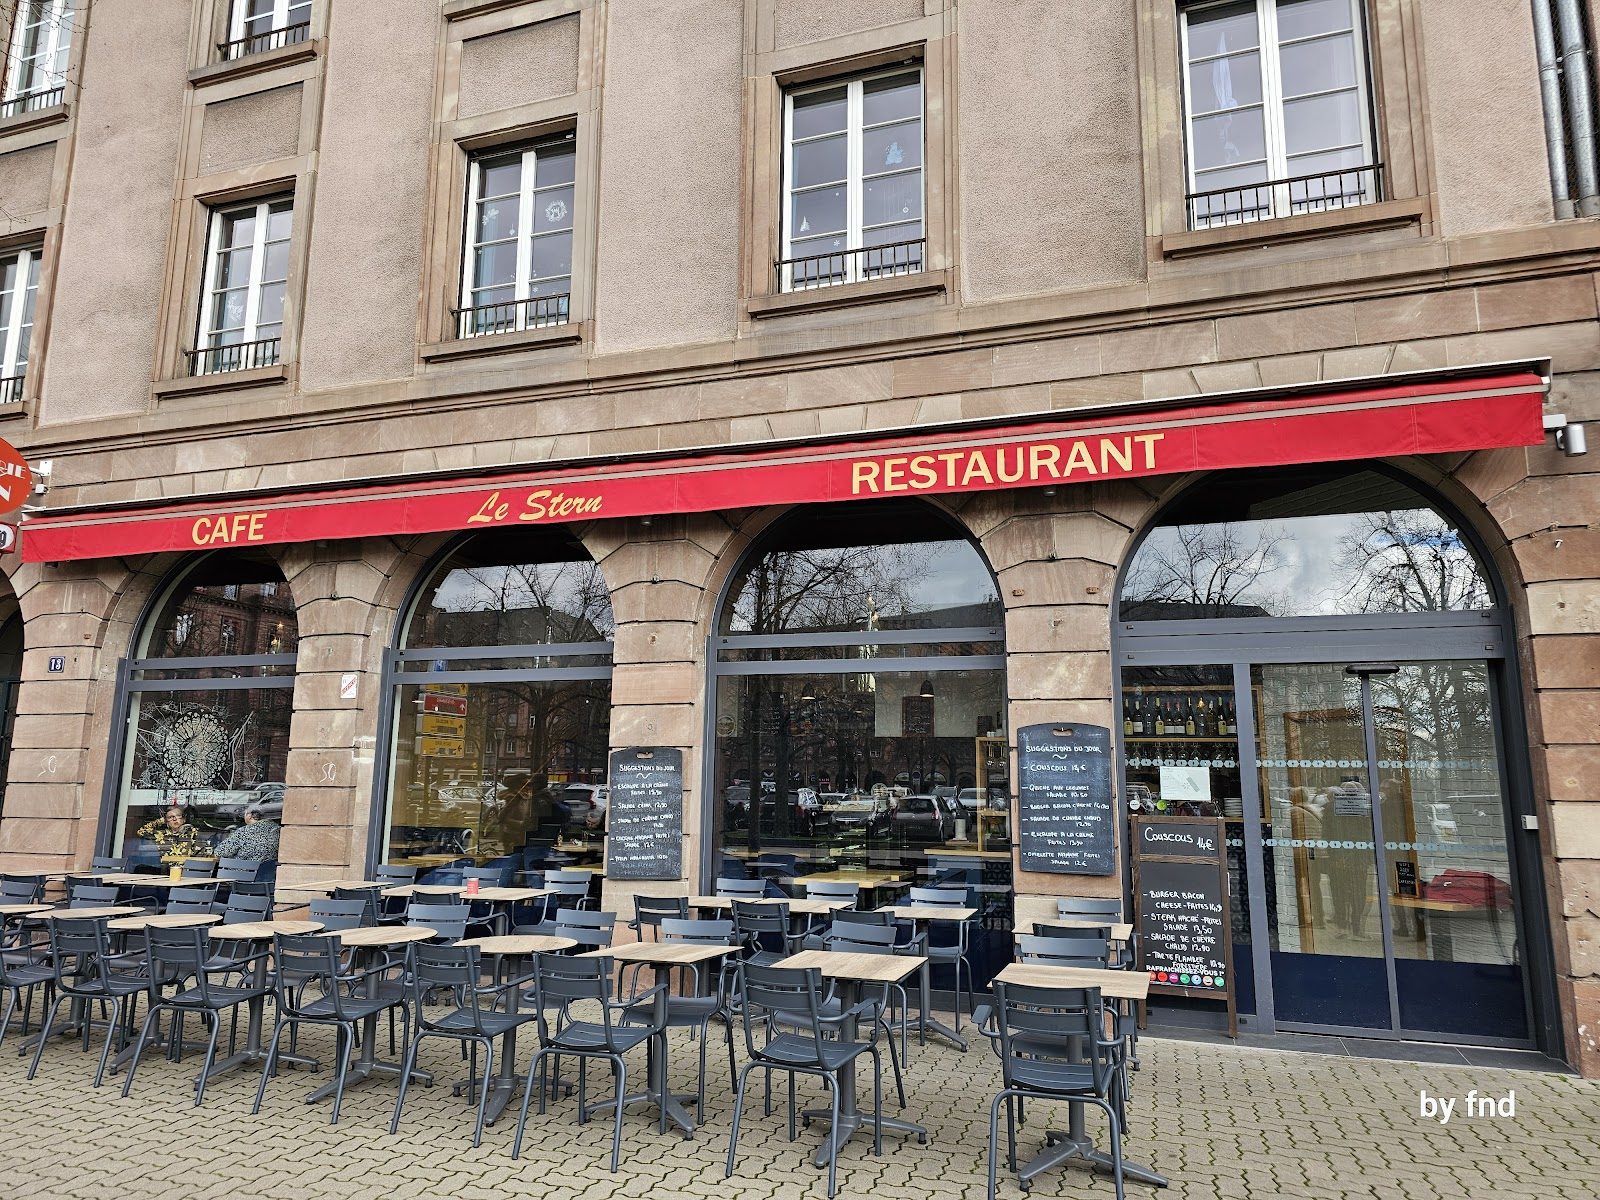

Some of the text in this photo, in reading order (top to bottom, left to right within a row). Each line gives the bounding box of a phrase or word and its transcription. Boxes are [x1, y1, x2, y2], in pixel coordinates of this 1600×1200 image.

[851, 433, 1165, 495] RESTAURANT
[467, 489, 603, 524] Le Stern
[191, 512, 268, 546] CAFE
[1030, 764, 1067, 772] COUSCOUS
[1144, 826, 1216, 851] Couscous 14€
[1149, 890, 1205, 900] BURGER BACON
[1150, 912, 1177, 922] STEAK
[1163, 922, 1188, 932] SALADE
[1150, 932, 1176, 942] SALADE
[1164, 943, 1188, 952] CHAUD
